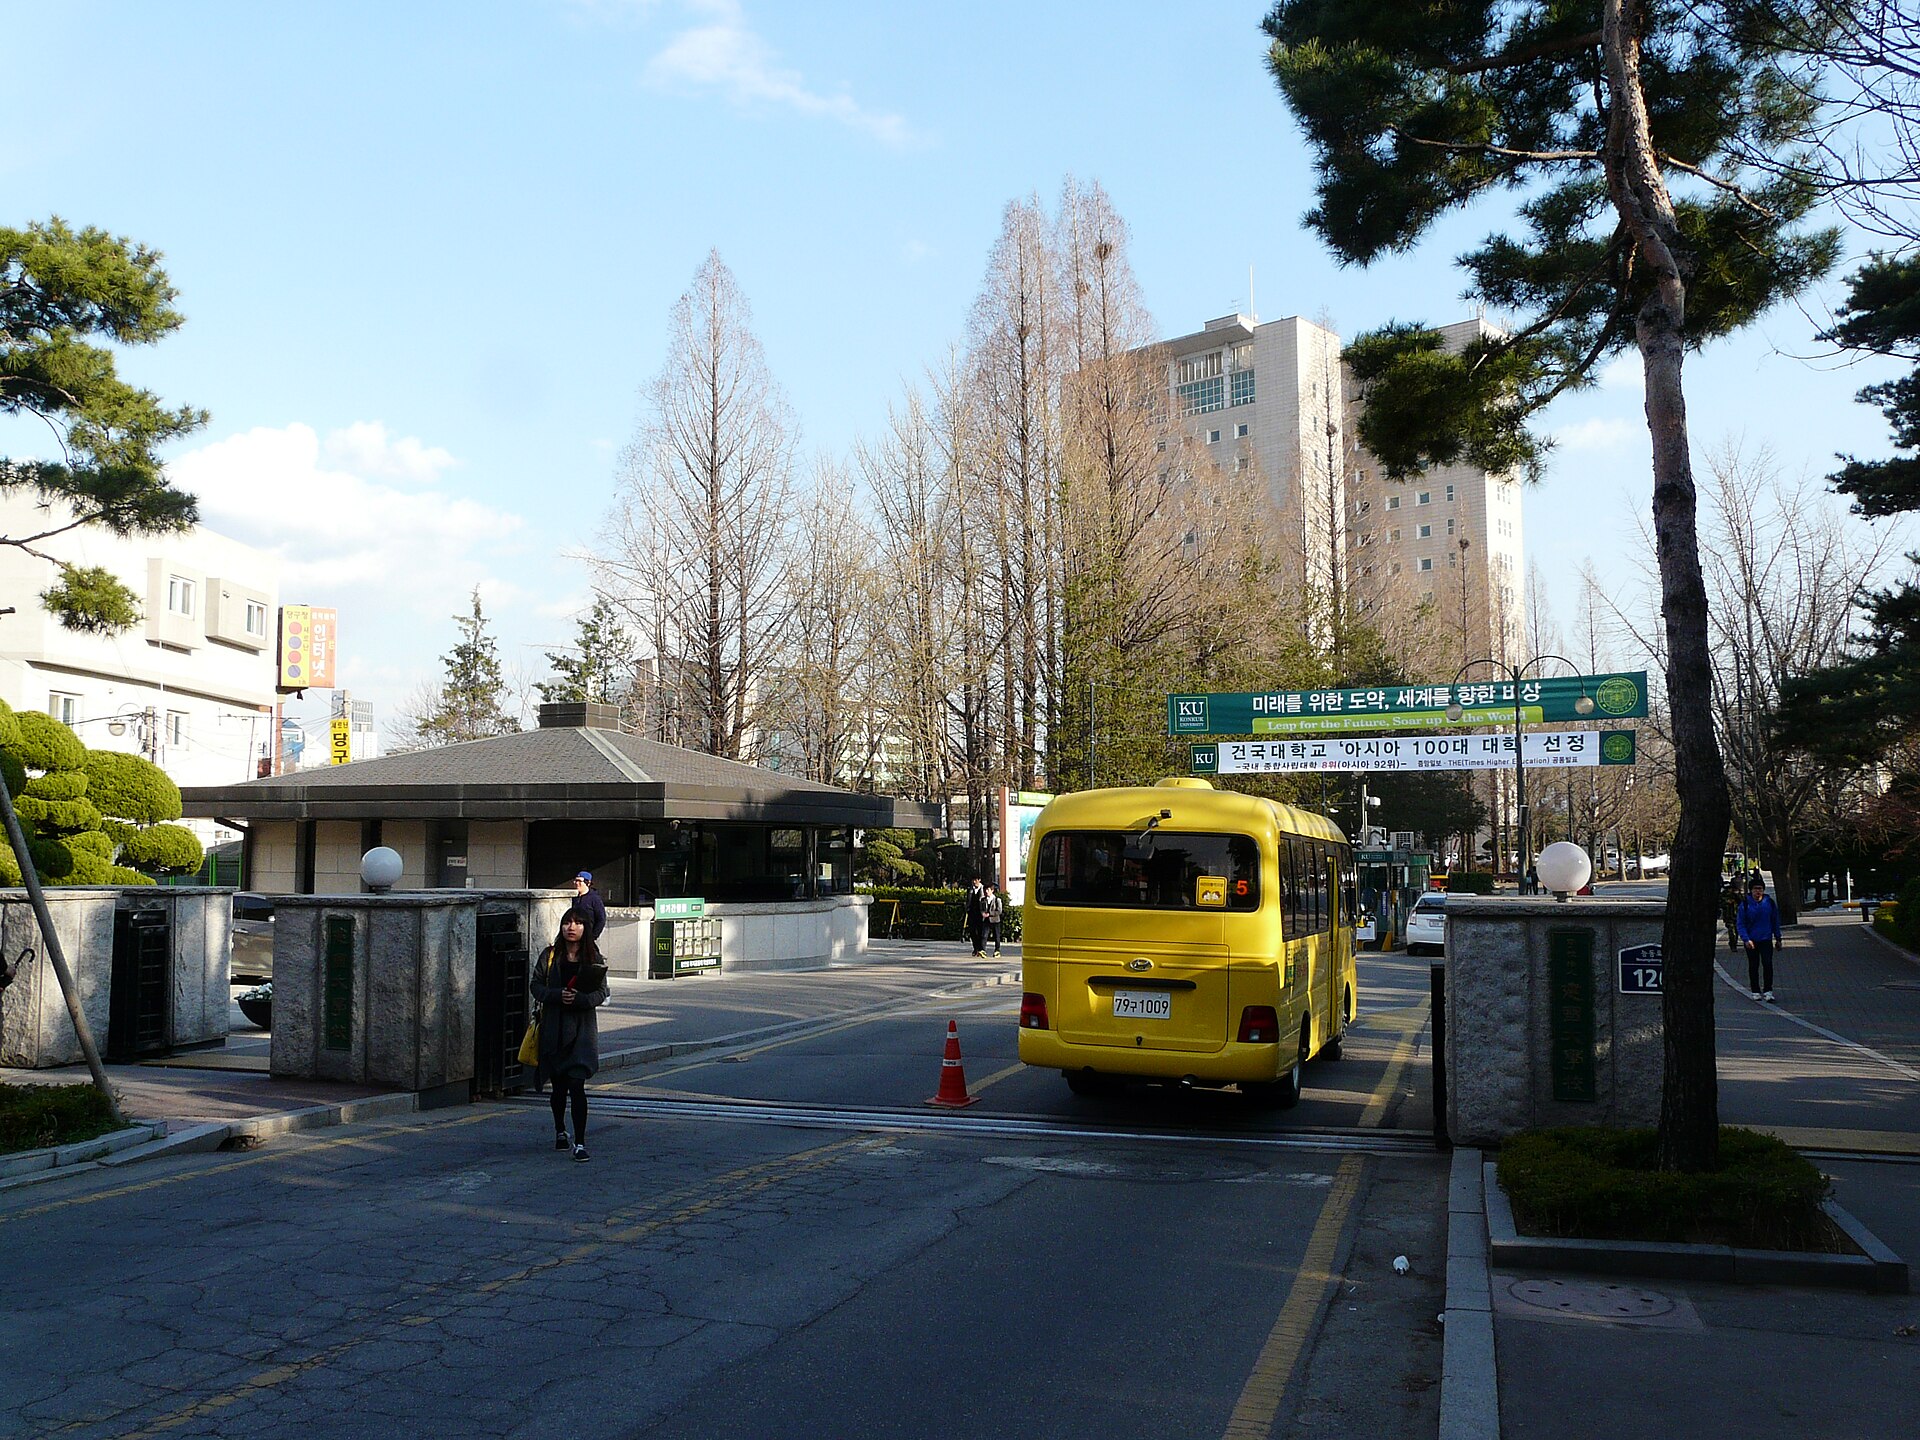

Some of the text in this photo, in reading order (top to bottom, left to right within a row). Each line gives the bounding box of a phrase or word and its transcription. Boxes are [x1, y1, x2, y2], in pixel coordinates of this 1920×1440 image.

[286, 609, 308, 619] 당구장
[312, 623, 327, 678] 인터넷
[1252, 693, 1303, 714] 미래를
[1308, 692, 1344, 712] 위한
[1348, 689, 1390, 711] 도약,
[1396, 687, 1452, 708] 세계를
[1457, 684, 1497, 706] 향한
[1178, 701, 1205, 716] KU
[1267, 721, 1297, 732] Leap
[1300, 719, 1318, 730] for
[1320, 718, 1341, 729] the
[1393, 715, 1425, 726] Soar
[1428, 718, 1443, 728] up
[1462, 712, 1484, 723] the
[333, 732, 349, 764] 당구
[1231, 743, 1328, 761] 건국대학교
[1339, 740, 1401, 758] '아시아
[1412, 737, 1469, 756] 100대
[1543, 734, 1586, 752] 선정
[1194, 753, 1214, 764] KU
[1263, 761, 1318, 771] 종합사립대학
[1447, 758, 1485, 767] THE(Times
[1486, 757, 1510, 767] Higher
[1236, 880, 1248, 896] 5
[658, 942, 670, 951] KU
[1114, 998, 1169, 1015] 79구1009
